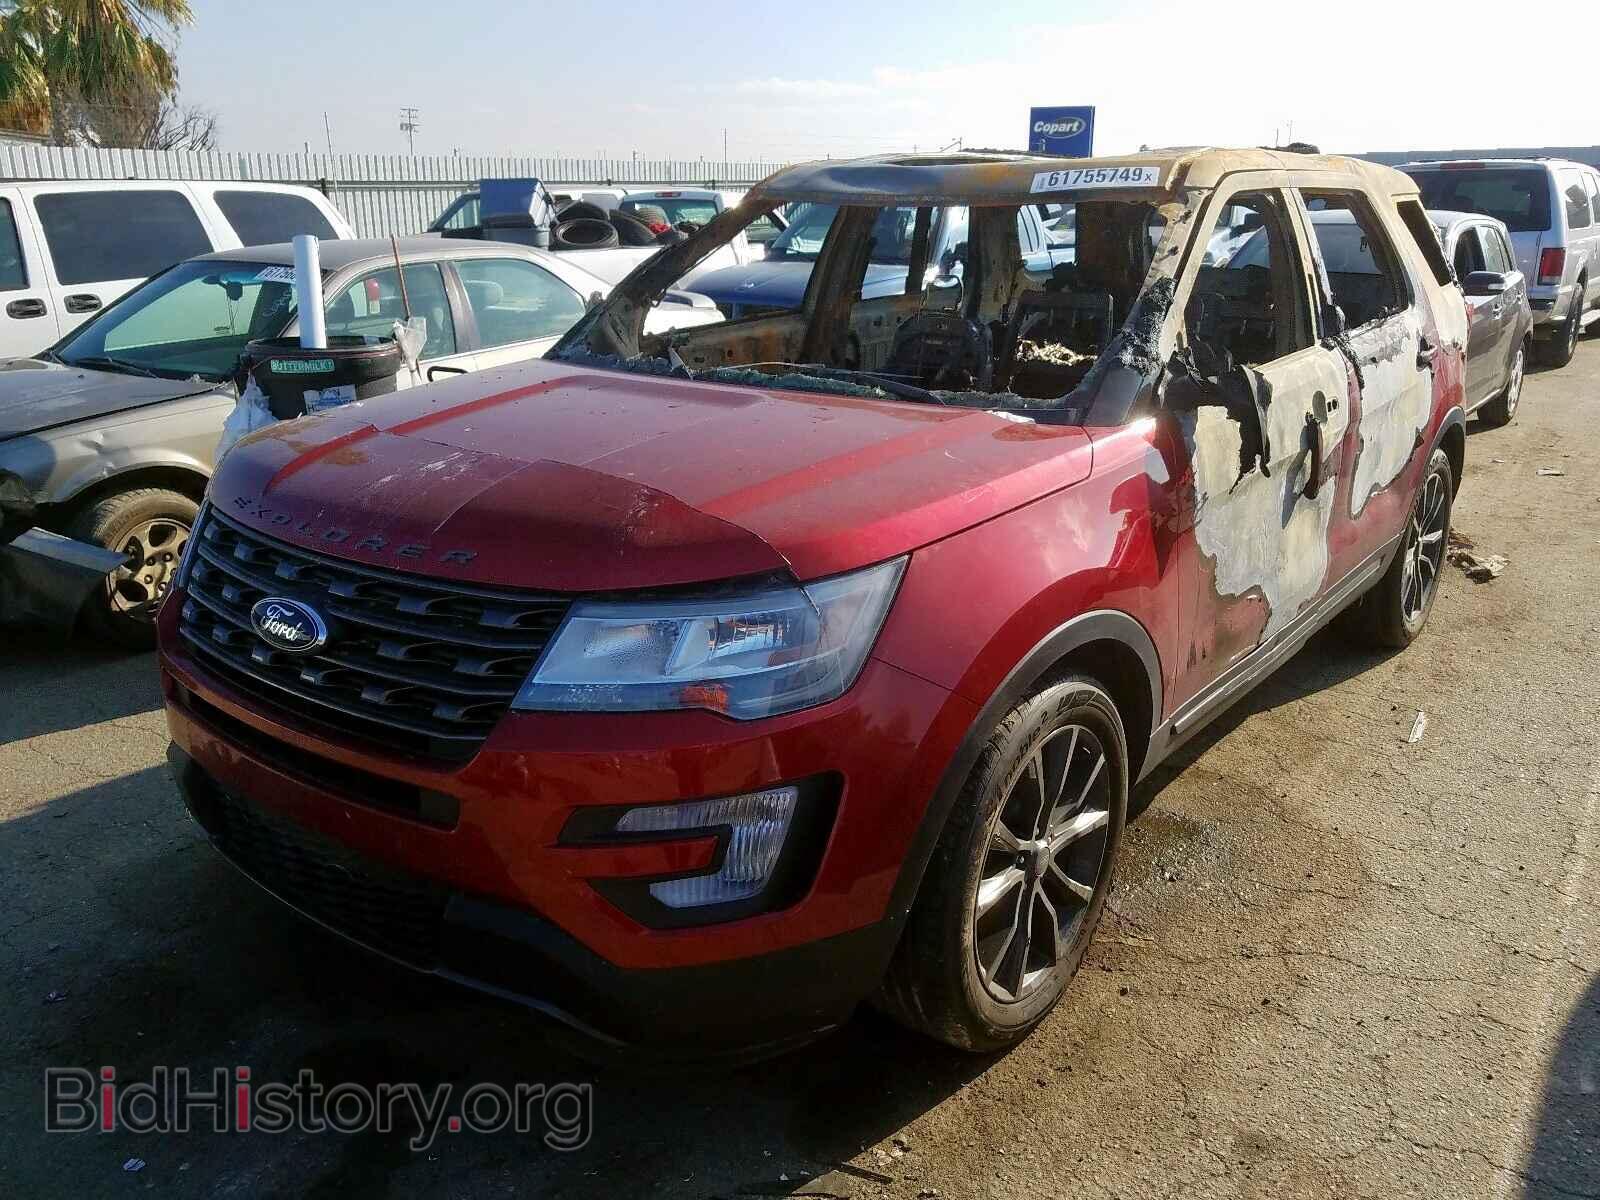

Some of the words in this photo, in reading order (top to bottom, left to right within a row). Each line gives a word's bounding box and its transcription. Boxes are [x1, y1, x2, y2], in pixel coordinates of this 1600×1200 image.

[1033, 119, 1080, 135] Copart
[233, 496, 478, 563] EXPLORER
[262, 603, 308, 642] Ford
